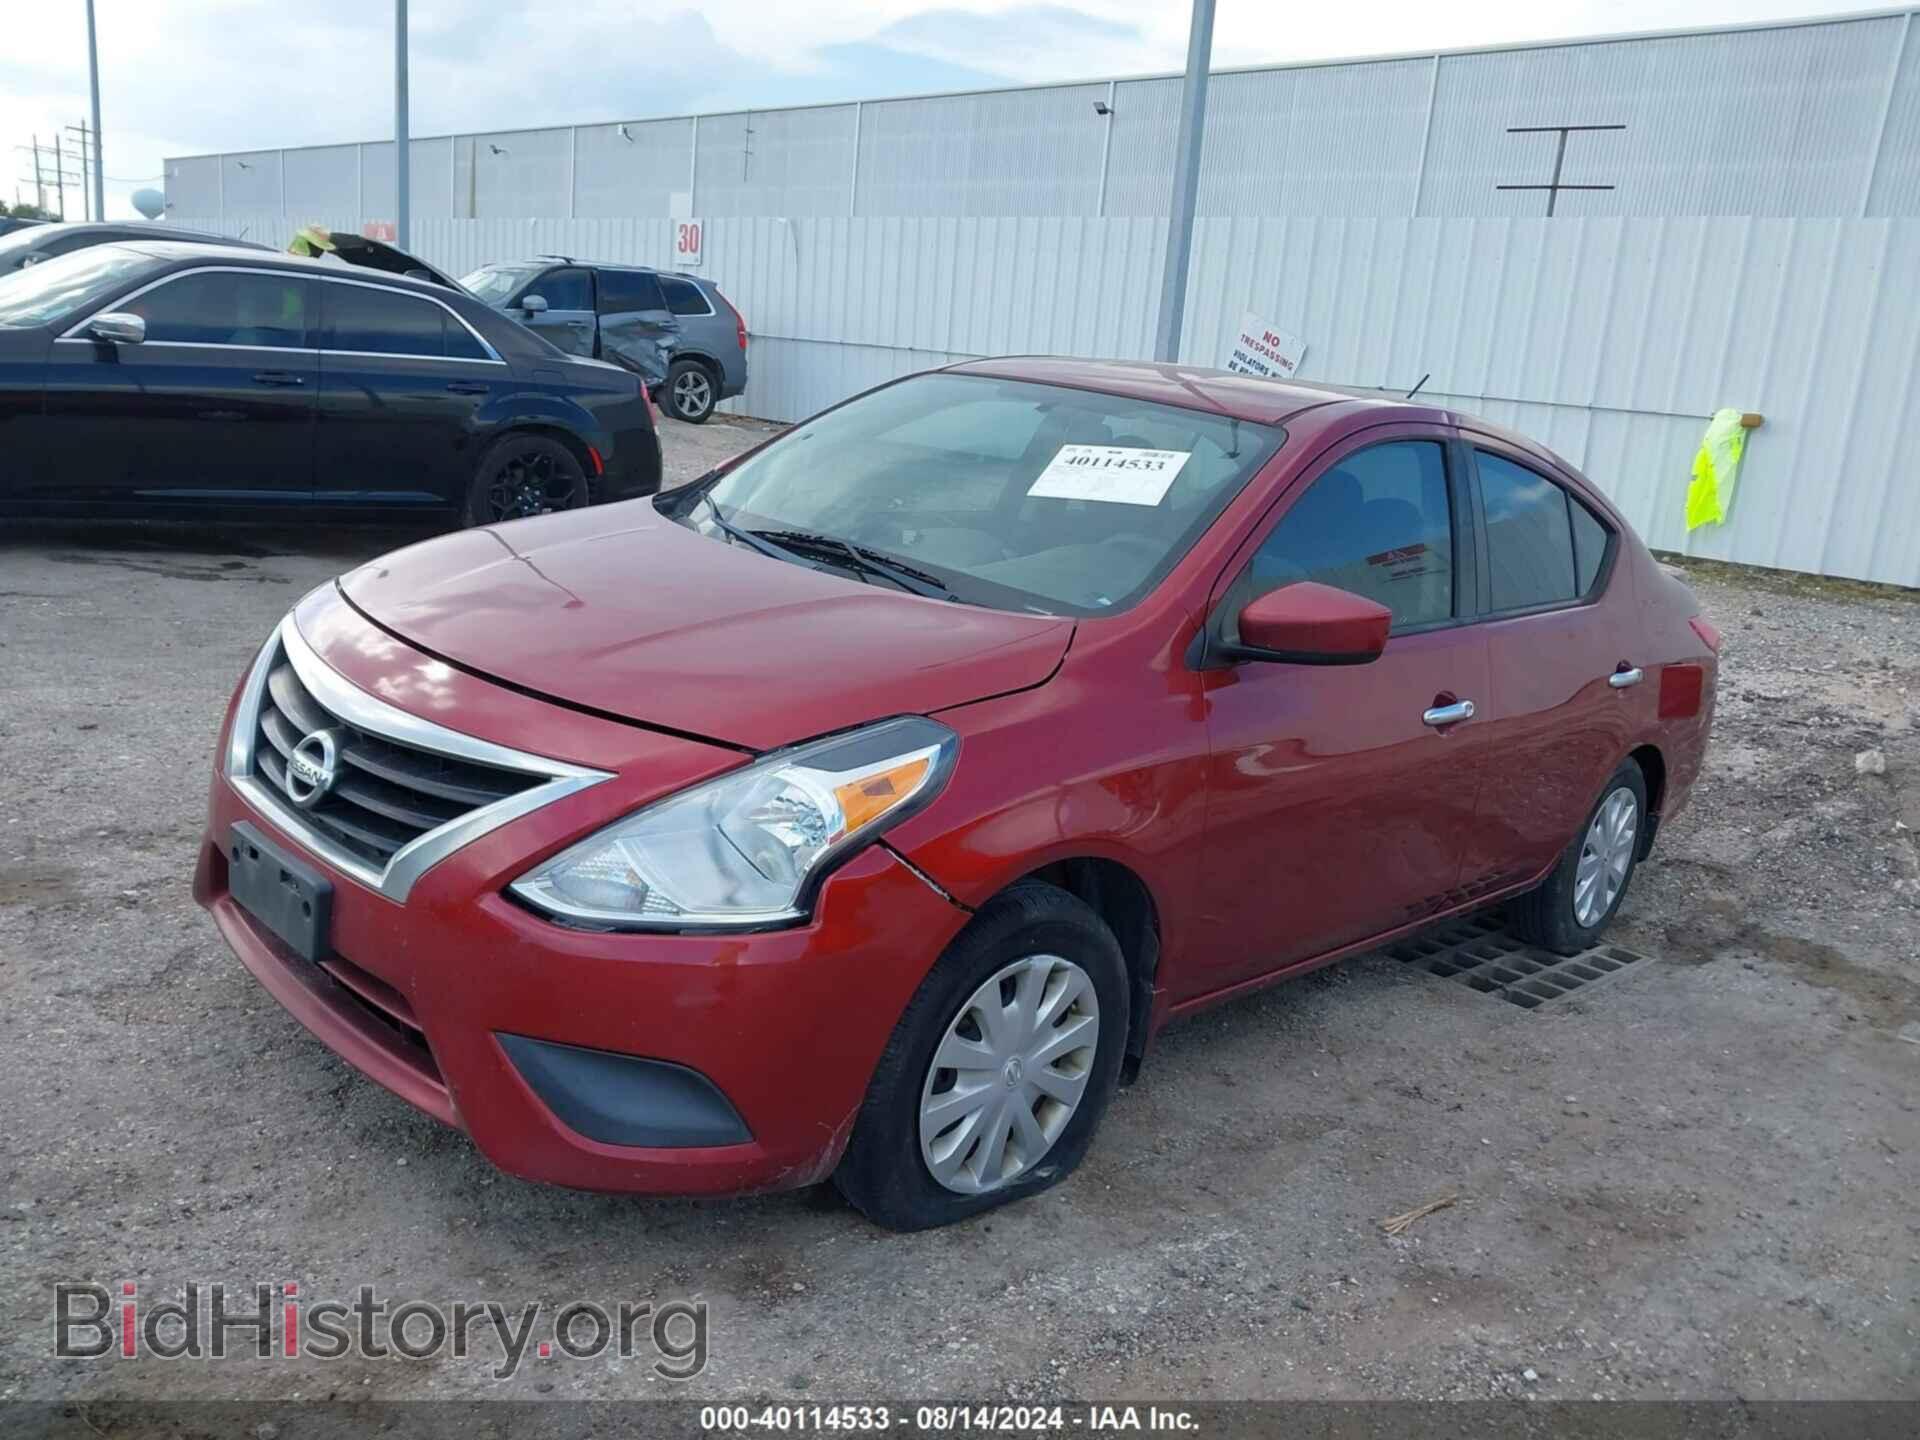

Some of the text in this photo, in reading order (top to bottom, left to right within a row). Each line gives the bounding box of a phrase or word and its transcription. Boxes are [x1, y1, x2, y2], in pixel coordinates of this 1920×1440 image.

[678, 223, 700, 253] 30
[1240, 333, 1295, 371] TRESPASSING
[1262, 330, 1281, 348] NO
[1233, 349, 1270, 376] VIOLATORS
[1064, 455, 1166, 471] 40114533
